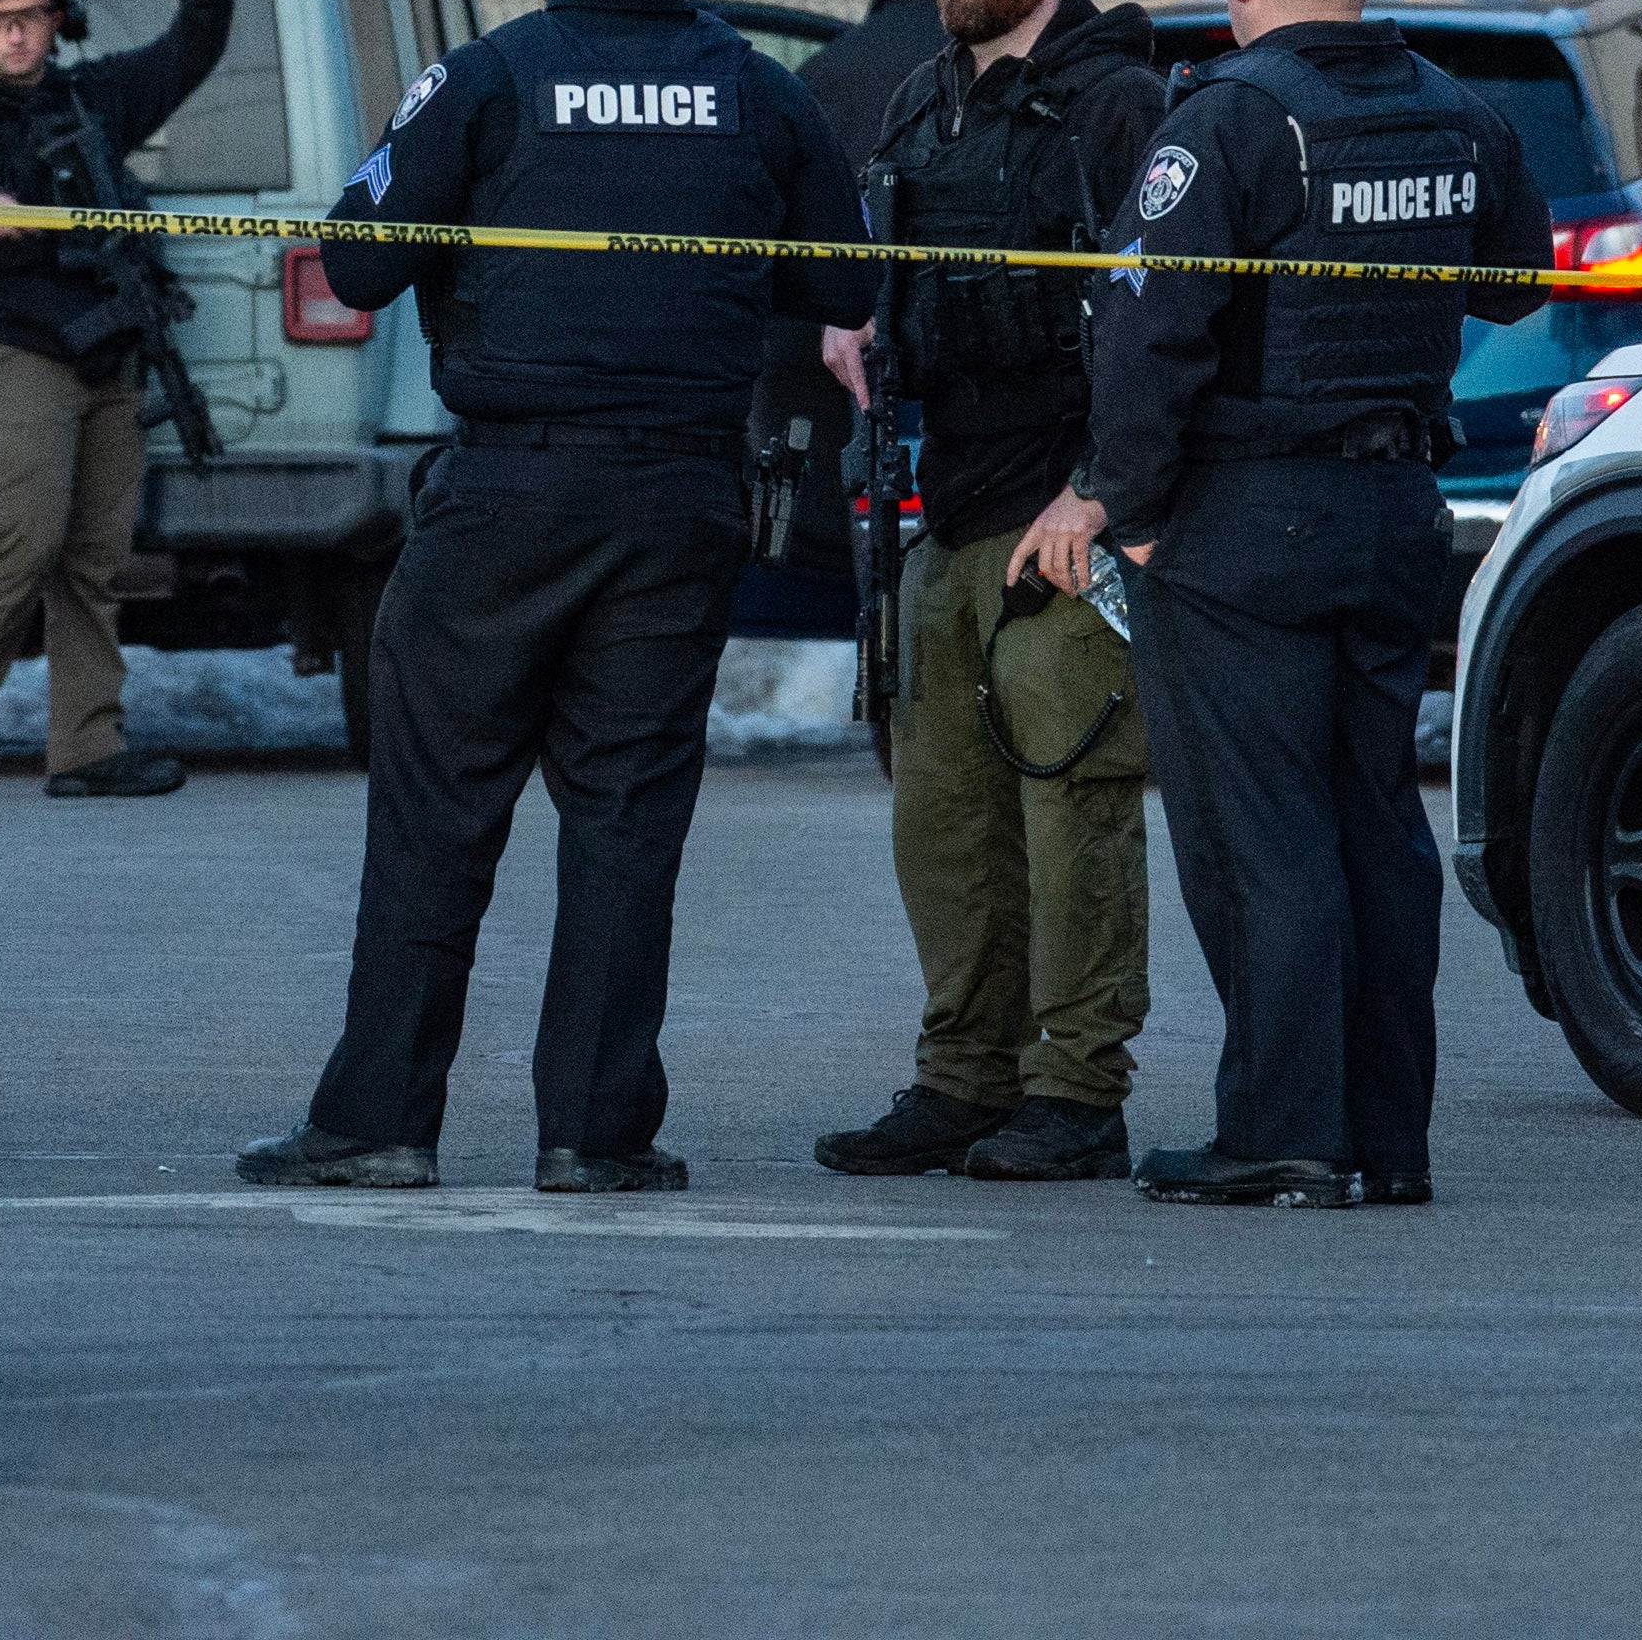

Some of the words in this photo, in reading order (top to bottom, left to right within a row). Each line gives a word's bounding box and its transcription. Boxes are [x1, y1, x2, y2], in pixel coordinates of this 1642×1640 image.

[555, 83, 718, 127] POLICE
[1332, 178, 1429, 224] POLICE
[1434, 171, 1477, 216] K-9
